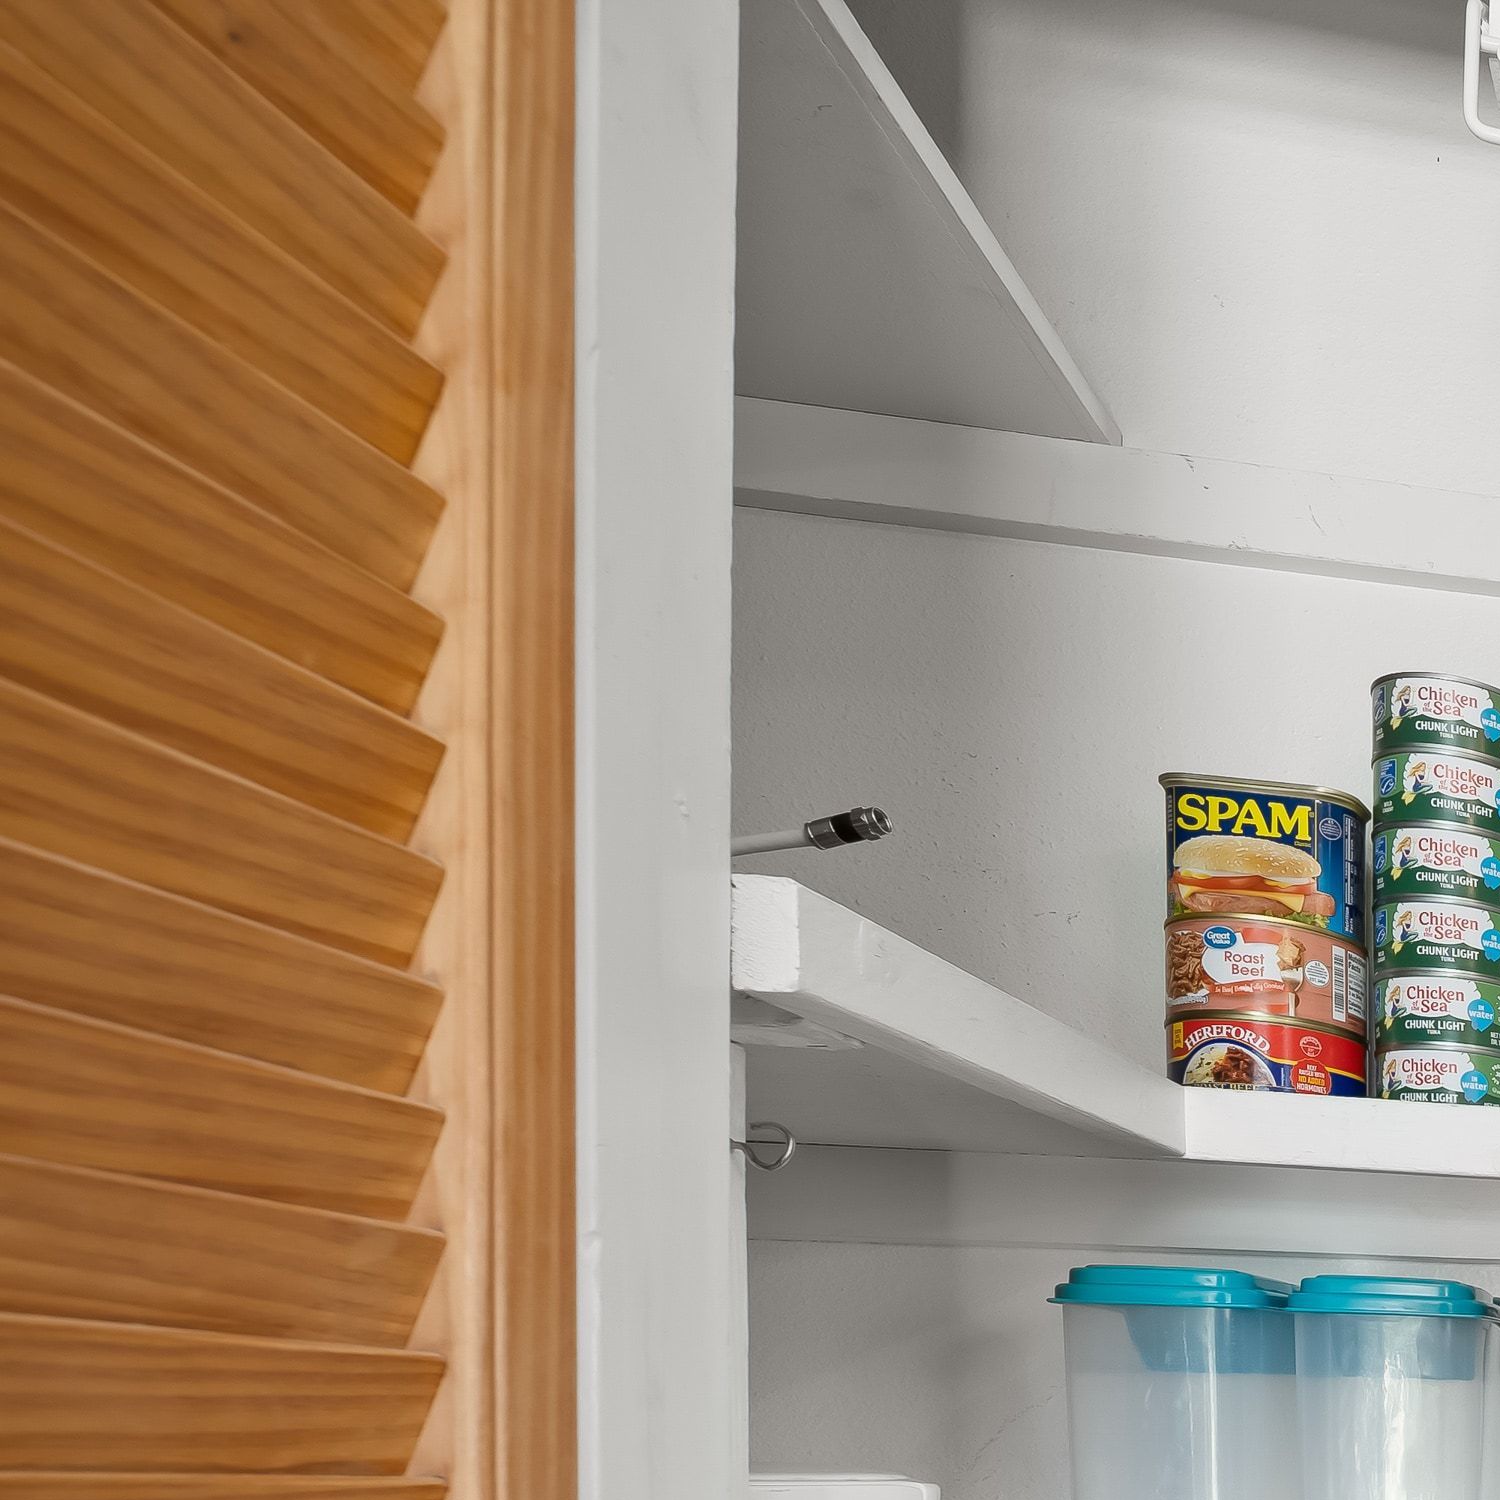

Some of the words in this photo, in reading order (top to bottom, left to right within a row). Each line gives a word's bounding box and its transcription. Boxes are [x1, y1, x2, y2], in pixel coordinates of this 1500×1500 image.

[1418, 687, 1478, 708] Chicken
[1433, 702, 1461, 716] Sea
[1415, 721, 1448, 732] CHUNK
[1451, 724, 1478, 738] LIGHT
[1177, 794, 1311, 841] SPAM
[1206, 932, 1230, 941] Great
[1224, 951, 1265, 965] Roast
[1232, 964, 1264, 977] Beef
[1407, 986, 1464, 1002] Chicken
[1421, 1001, 1447, 1012] Sea
[1405, 1020, 1435, 1029] CHUNK
[1438, 1021, 1465, 1031] LIGHT
[1185, 1025, 1270, 1054] HEREFORD
